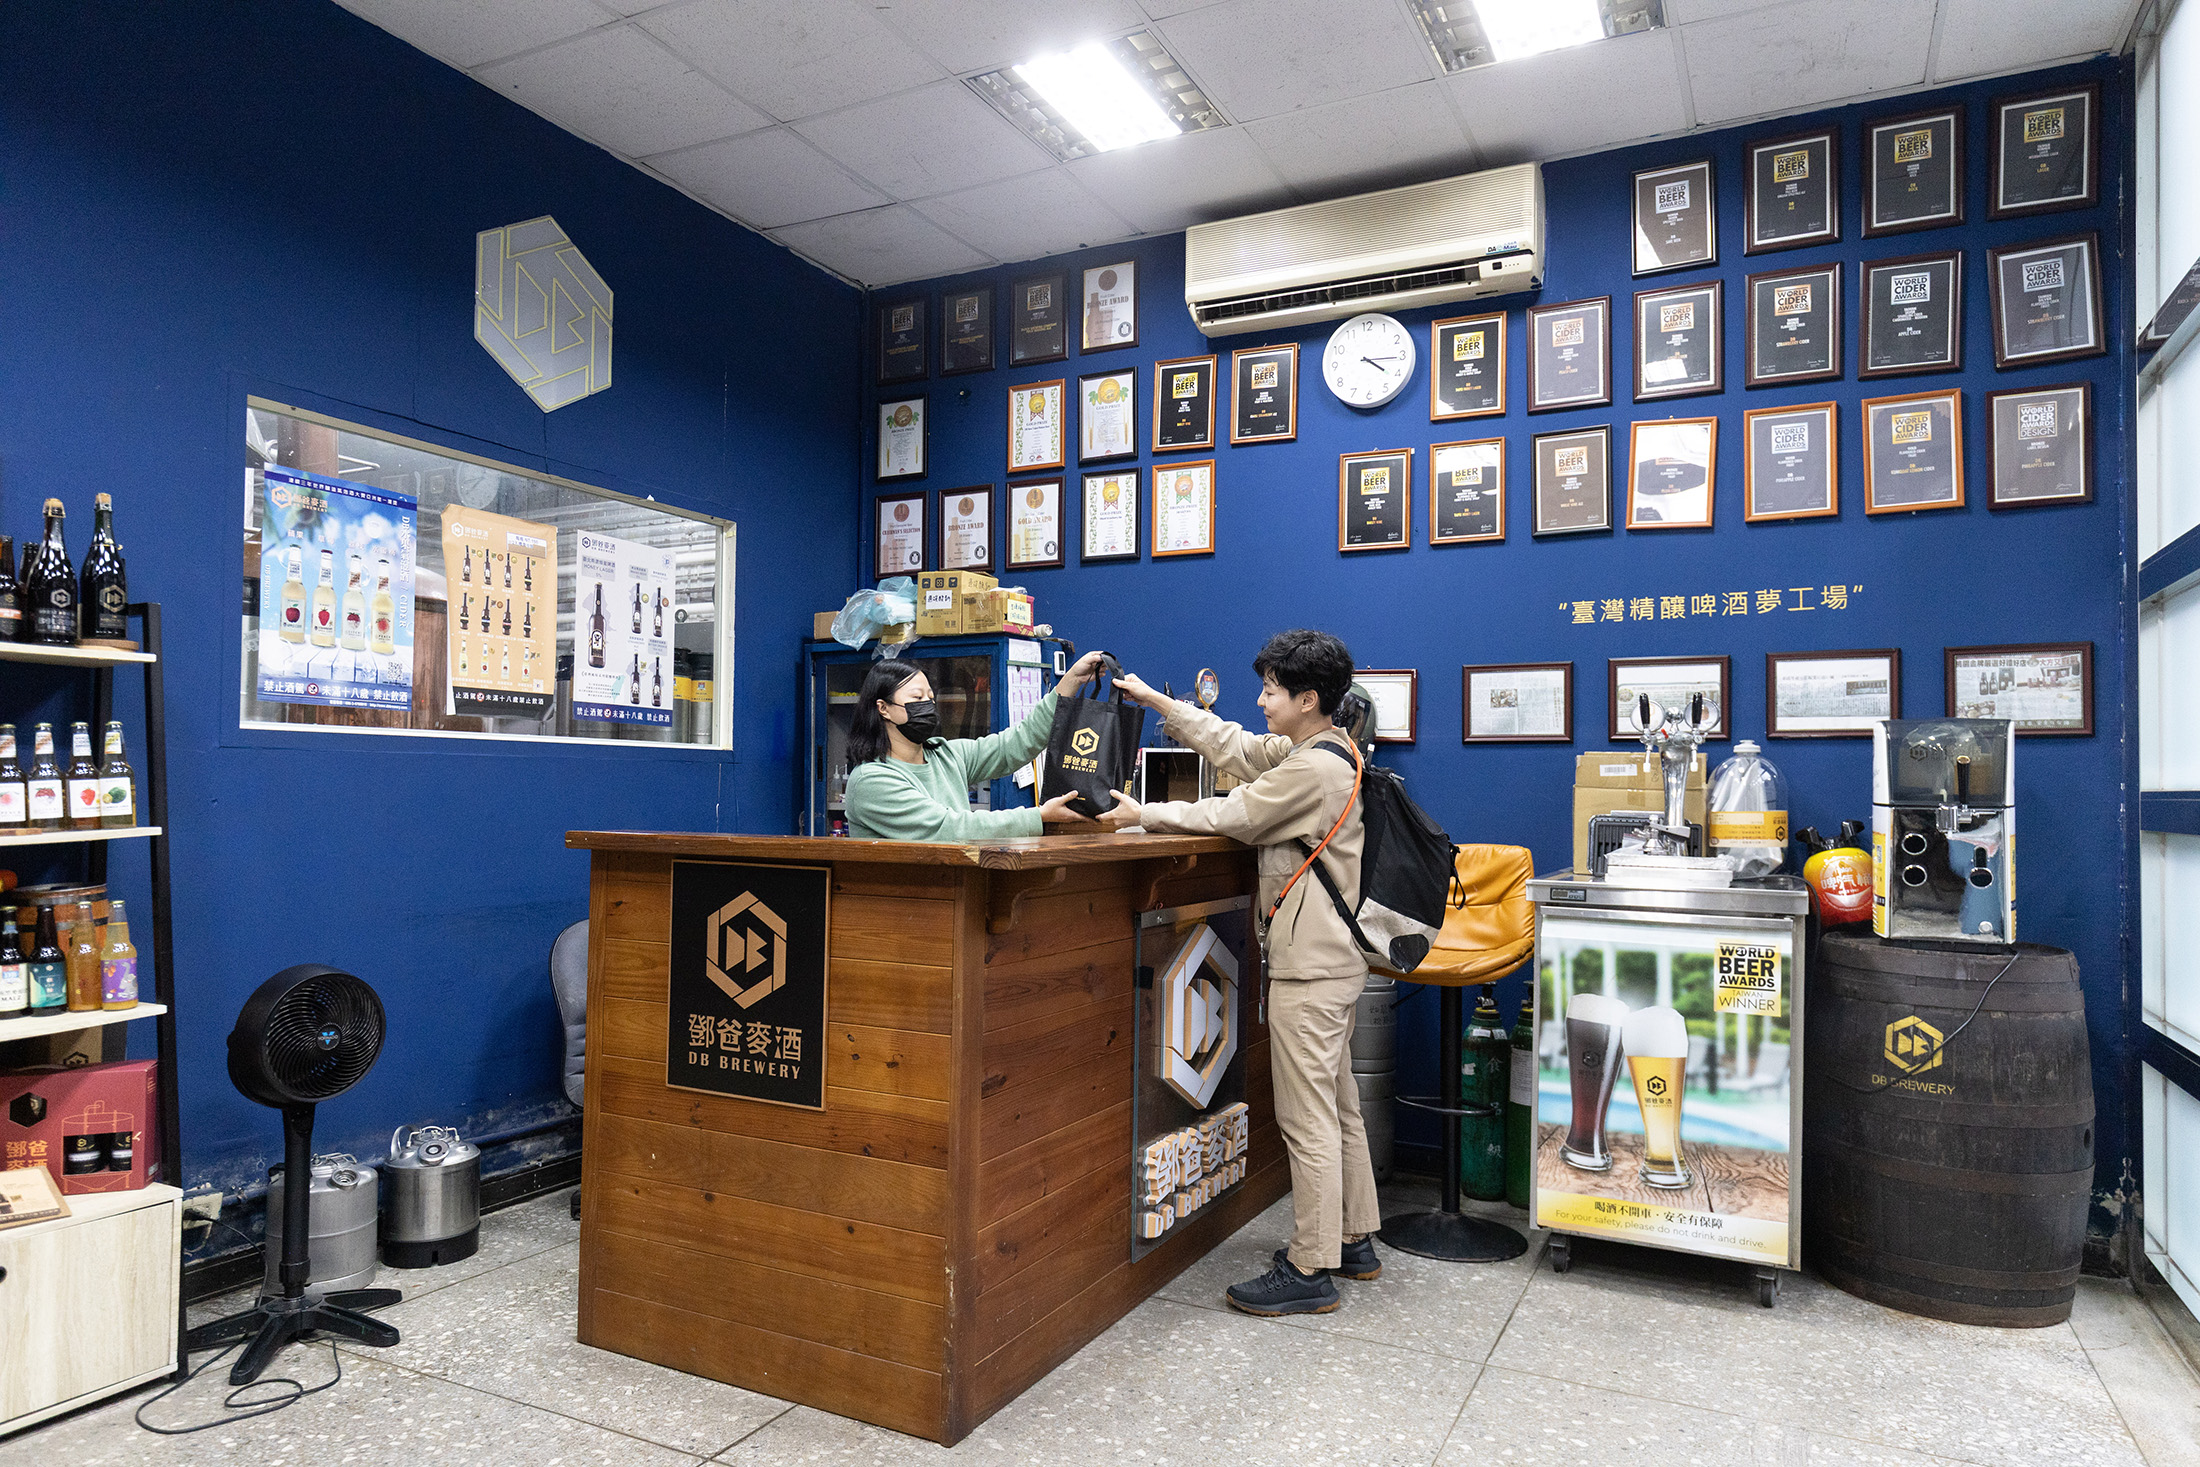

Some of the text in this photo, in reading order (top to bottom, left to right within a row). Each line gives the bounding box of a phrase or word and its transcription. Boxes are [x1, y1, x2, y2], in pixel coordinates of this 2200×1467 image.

[2028, 113, 2061, 123] WORLD
[2029, 120, 2060, 132] BEER
[2028, 129, 2061, 138] AWARDS
[1898, 134, 1929, 144] WORLD
[1898, 140, 1928, 153] BEER
[1777, 155, 1806, 164] WORLD
[1898, 150, 1929, 159] AWARDS
[1777, 161, 1805, 172] BEER
[1777, 170, 1806, 178] AWARDS
[1659, 185, 1686, 195] WORLD
[1659, 192, 1685, 203] BEER
[1660, 200, 1686, 208] AWARDS
[2025, 263, 2060, 274] WORLD
[2026, 270, 2060, 281] CIDER
[1894, 277, 1927, 286] WORLD
[2026, 278, 2061, 288] AWARDS
[1777, 289, 1808, 298] WORLD
[1894, 284, 1926, 294] CIDER
[1778, 296, 1808, 306] CIDER
[1894, 292, 1927, 300] AWARDS
[1663, 307, 1690, 315] WORLD
[1778, 303, 1808, 311] AWARDS
[1663, 313, 1690, 322] CIDER
[1362, 321, 1373, 332] 12
[1664, 320, 1691, 328] AWARDS
[1346, 330, 1355, 340] 11
[1555, 328, 1580, 337] CIDER
[1394, 334, 1400, 344] 2
[1334, 345, 1345, 355] 10
[1457, 342, 1480, 351] BEER
[1400, 350, 1406, 360] 3
[1332, 362, 1338, 371] 9
[1254, 372, 1274, 380] BEER
[1175, 382, 1195, 390] BEER
[1337, 377, 1343, 387] 8
[1350, 388, 1357, 398] 7
[1382, 383, 1389, 393] 5
[1366, 390, 1372, 400] 6
[2020, 406, 2054, 414] WORLD
[1895, 416, 1928, 425] WORLD
[2020, 413, 2054, 422] CIDER
[1774, 428, 1805, 436] WORLD
[1895, 423, 1927, 433] CIDER
[2021, 427, 2055, 436] DESIGN
[1774, 434, 1805, 444] CIDER
[1896, 431, 1928, 439] AWARDS
[1559, 456, 1583, 466] BEER
[1455, 467, 1478, 476] BEER
[1364, 477, 1385, 486] BEER
[400, 594, 408, 628] CIDER
[264, 680, 304, 694] 禁止酒駕
[373, 690, 408, 702] 禁止飲酒
[576, 707, 603, 717] 禁止酒駕
[646, 713, 670, 722] 禁止飲酒
[1720, 946, 1775, 958] WORLD
[1720, 957, 1774, 977] BEER
[1720, 975, 1775, 988] AWARDS
[1732, 990, 1763, 998] TAIWAN
[1719, 996, 1775, 1011] WINNER
[688, 1014, 803, 1062] 鄧爸麥酒
[688, 1051, 801, 1080] DB BREWERY
[1872, 1074, 1887, 1085] DB
[6, 1140, 48, 1158] 鄧爸
[1145, 1102, 1249, 1206] 鄧爸麥酒
[1143, 1157, 1247, 1238] DB BREWERY
[1556, 1210, 1766, 1248] For your safety, please do not drink and drive.
